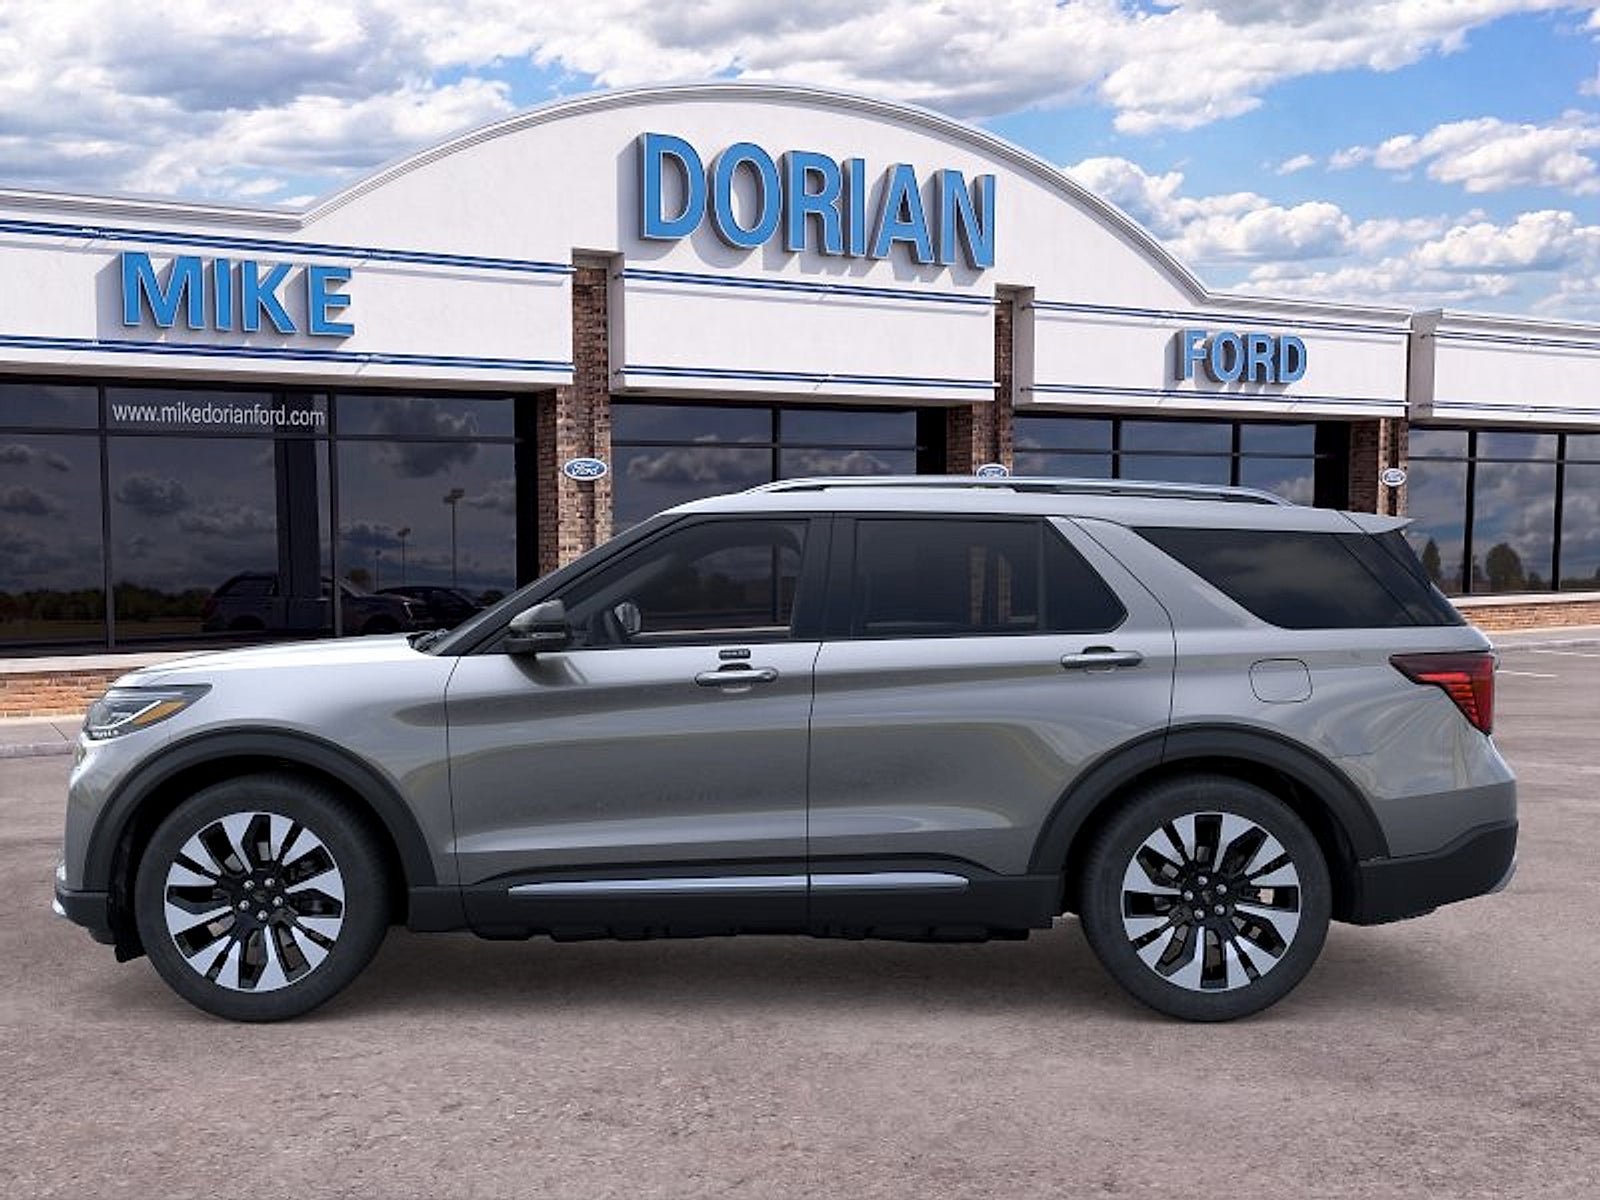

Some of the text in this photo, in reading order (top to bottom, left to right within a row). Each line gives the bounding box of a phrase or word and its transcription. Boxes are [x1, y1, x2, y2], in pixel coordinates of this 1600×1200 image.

[640, 131, 996, 270] DORIAN
[121, 251, 355, 337] MIKE
[1180, 327, 1308, 384] FORD
[112, 401, 326, 427] www.mikedorianford.com
